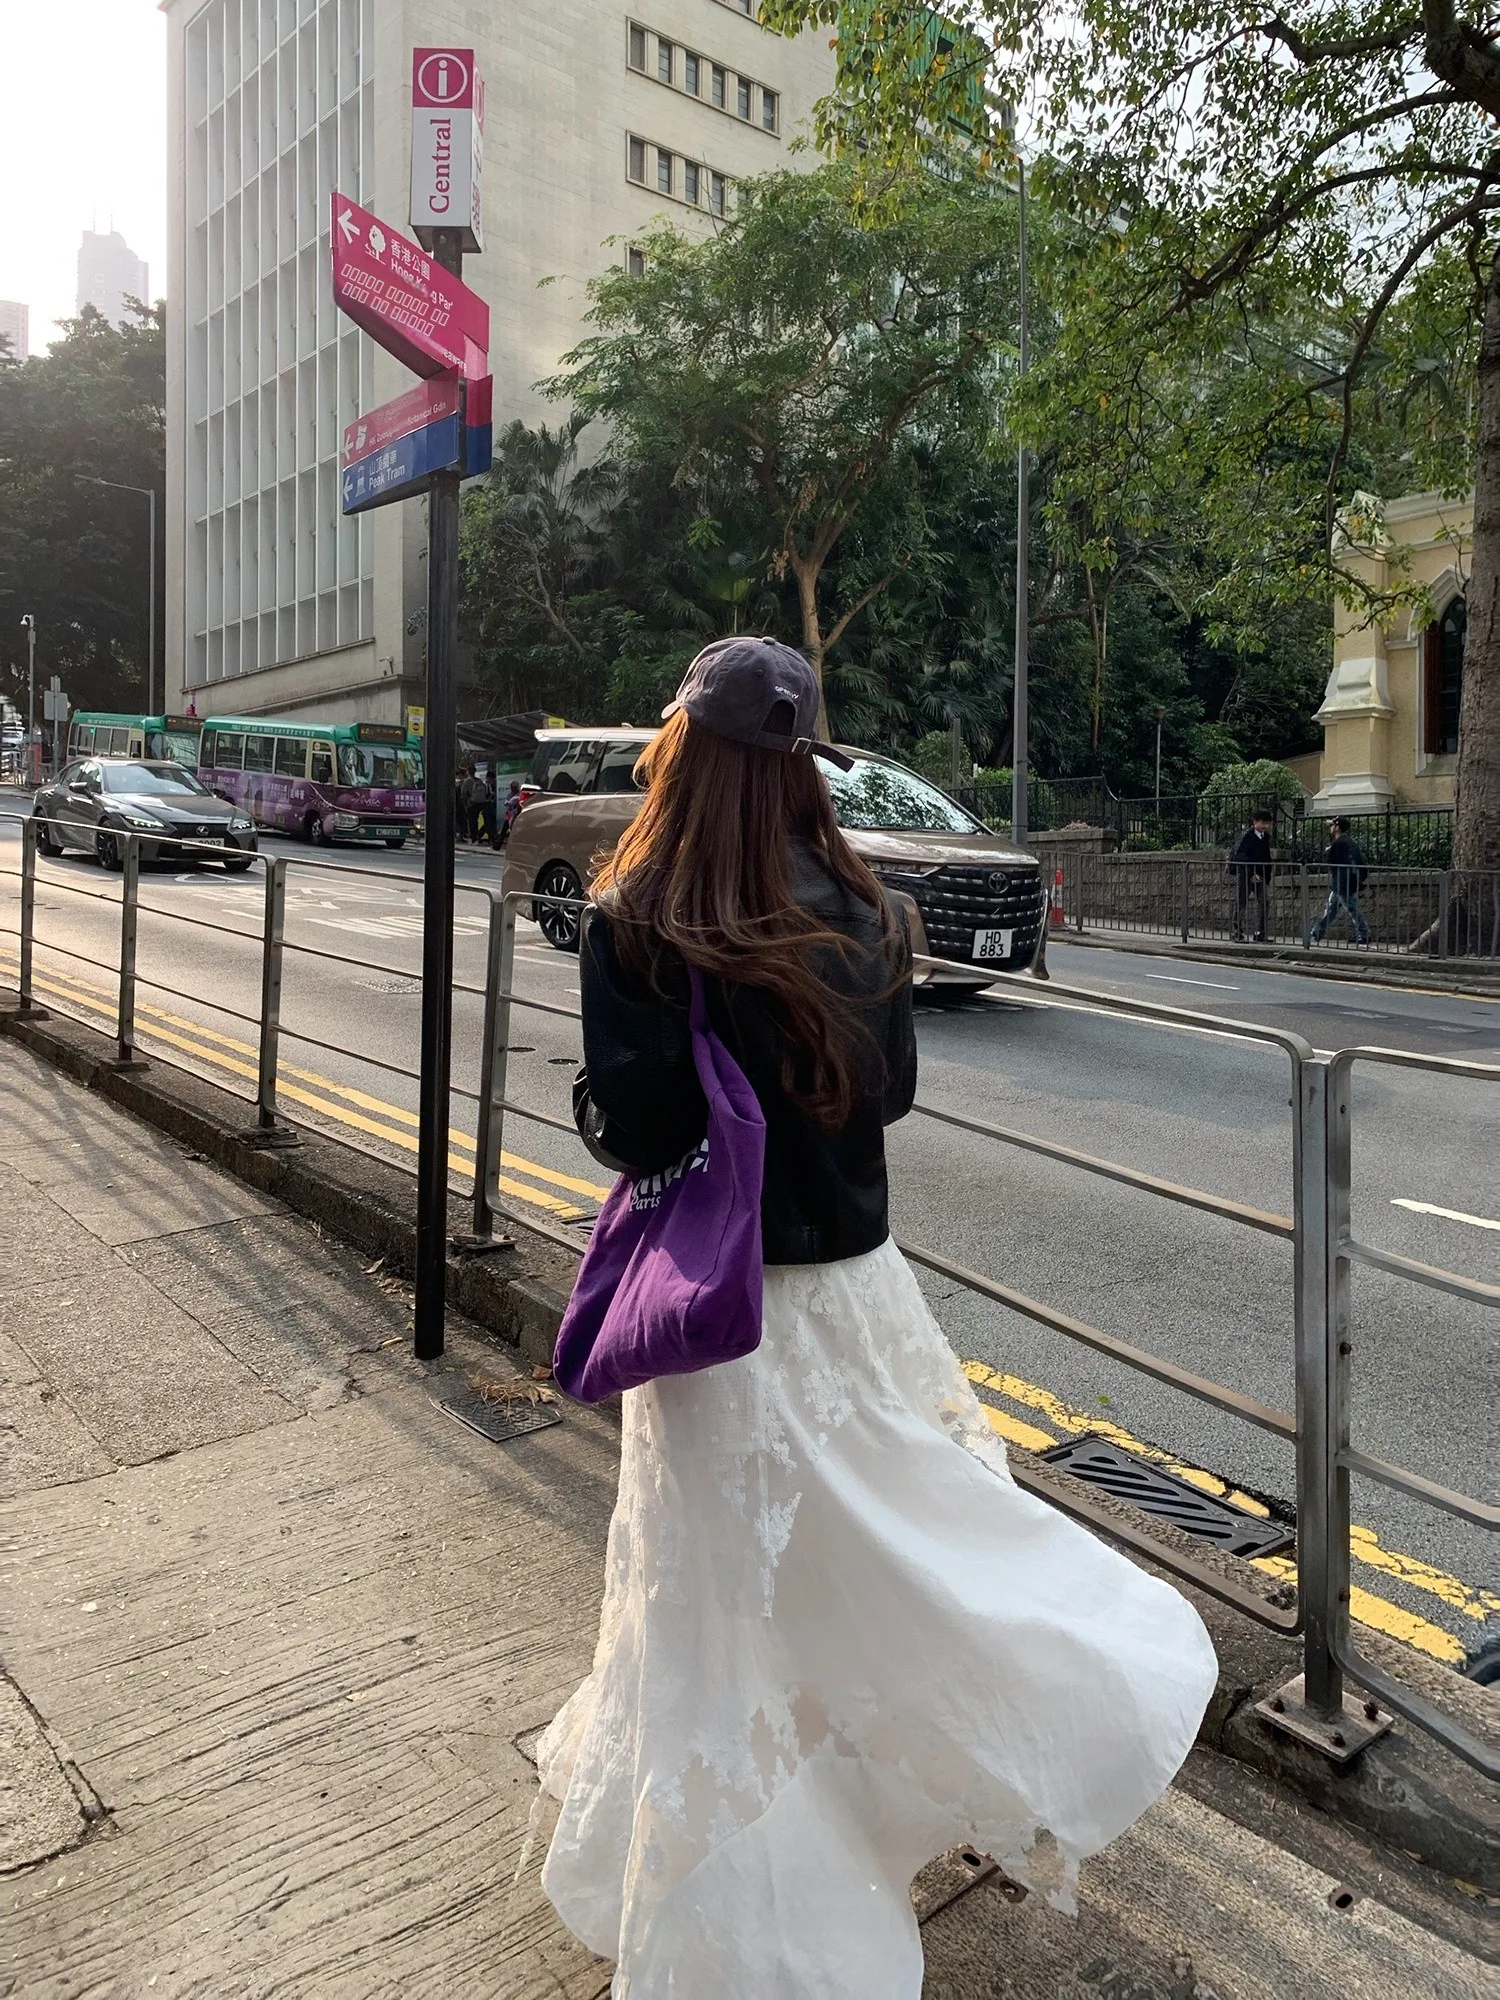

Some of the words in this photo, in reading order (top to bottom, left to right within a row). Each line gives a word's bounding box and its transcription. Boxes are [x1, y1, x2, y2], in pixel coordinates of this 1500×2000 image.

[429, 118, 451, 214] Central
[391, 238, 430, 281] 香港公園
[438, 292, 453, 311] Par
[368, 471, 385, 491] Peak
[386, 464, 406, 482] Tram
[985, 931, 1002, 944] HD
[979, 943, 1004, 957] 883
[628, 1191, 662, 1213] Paris
